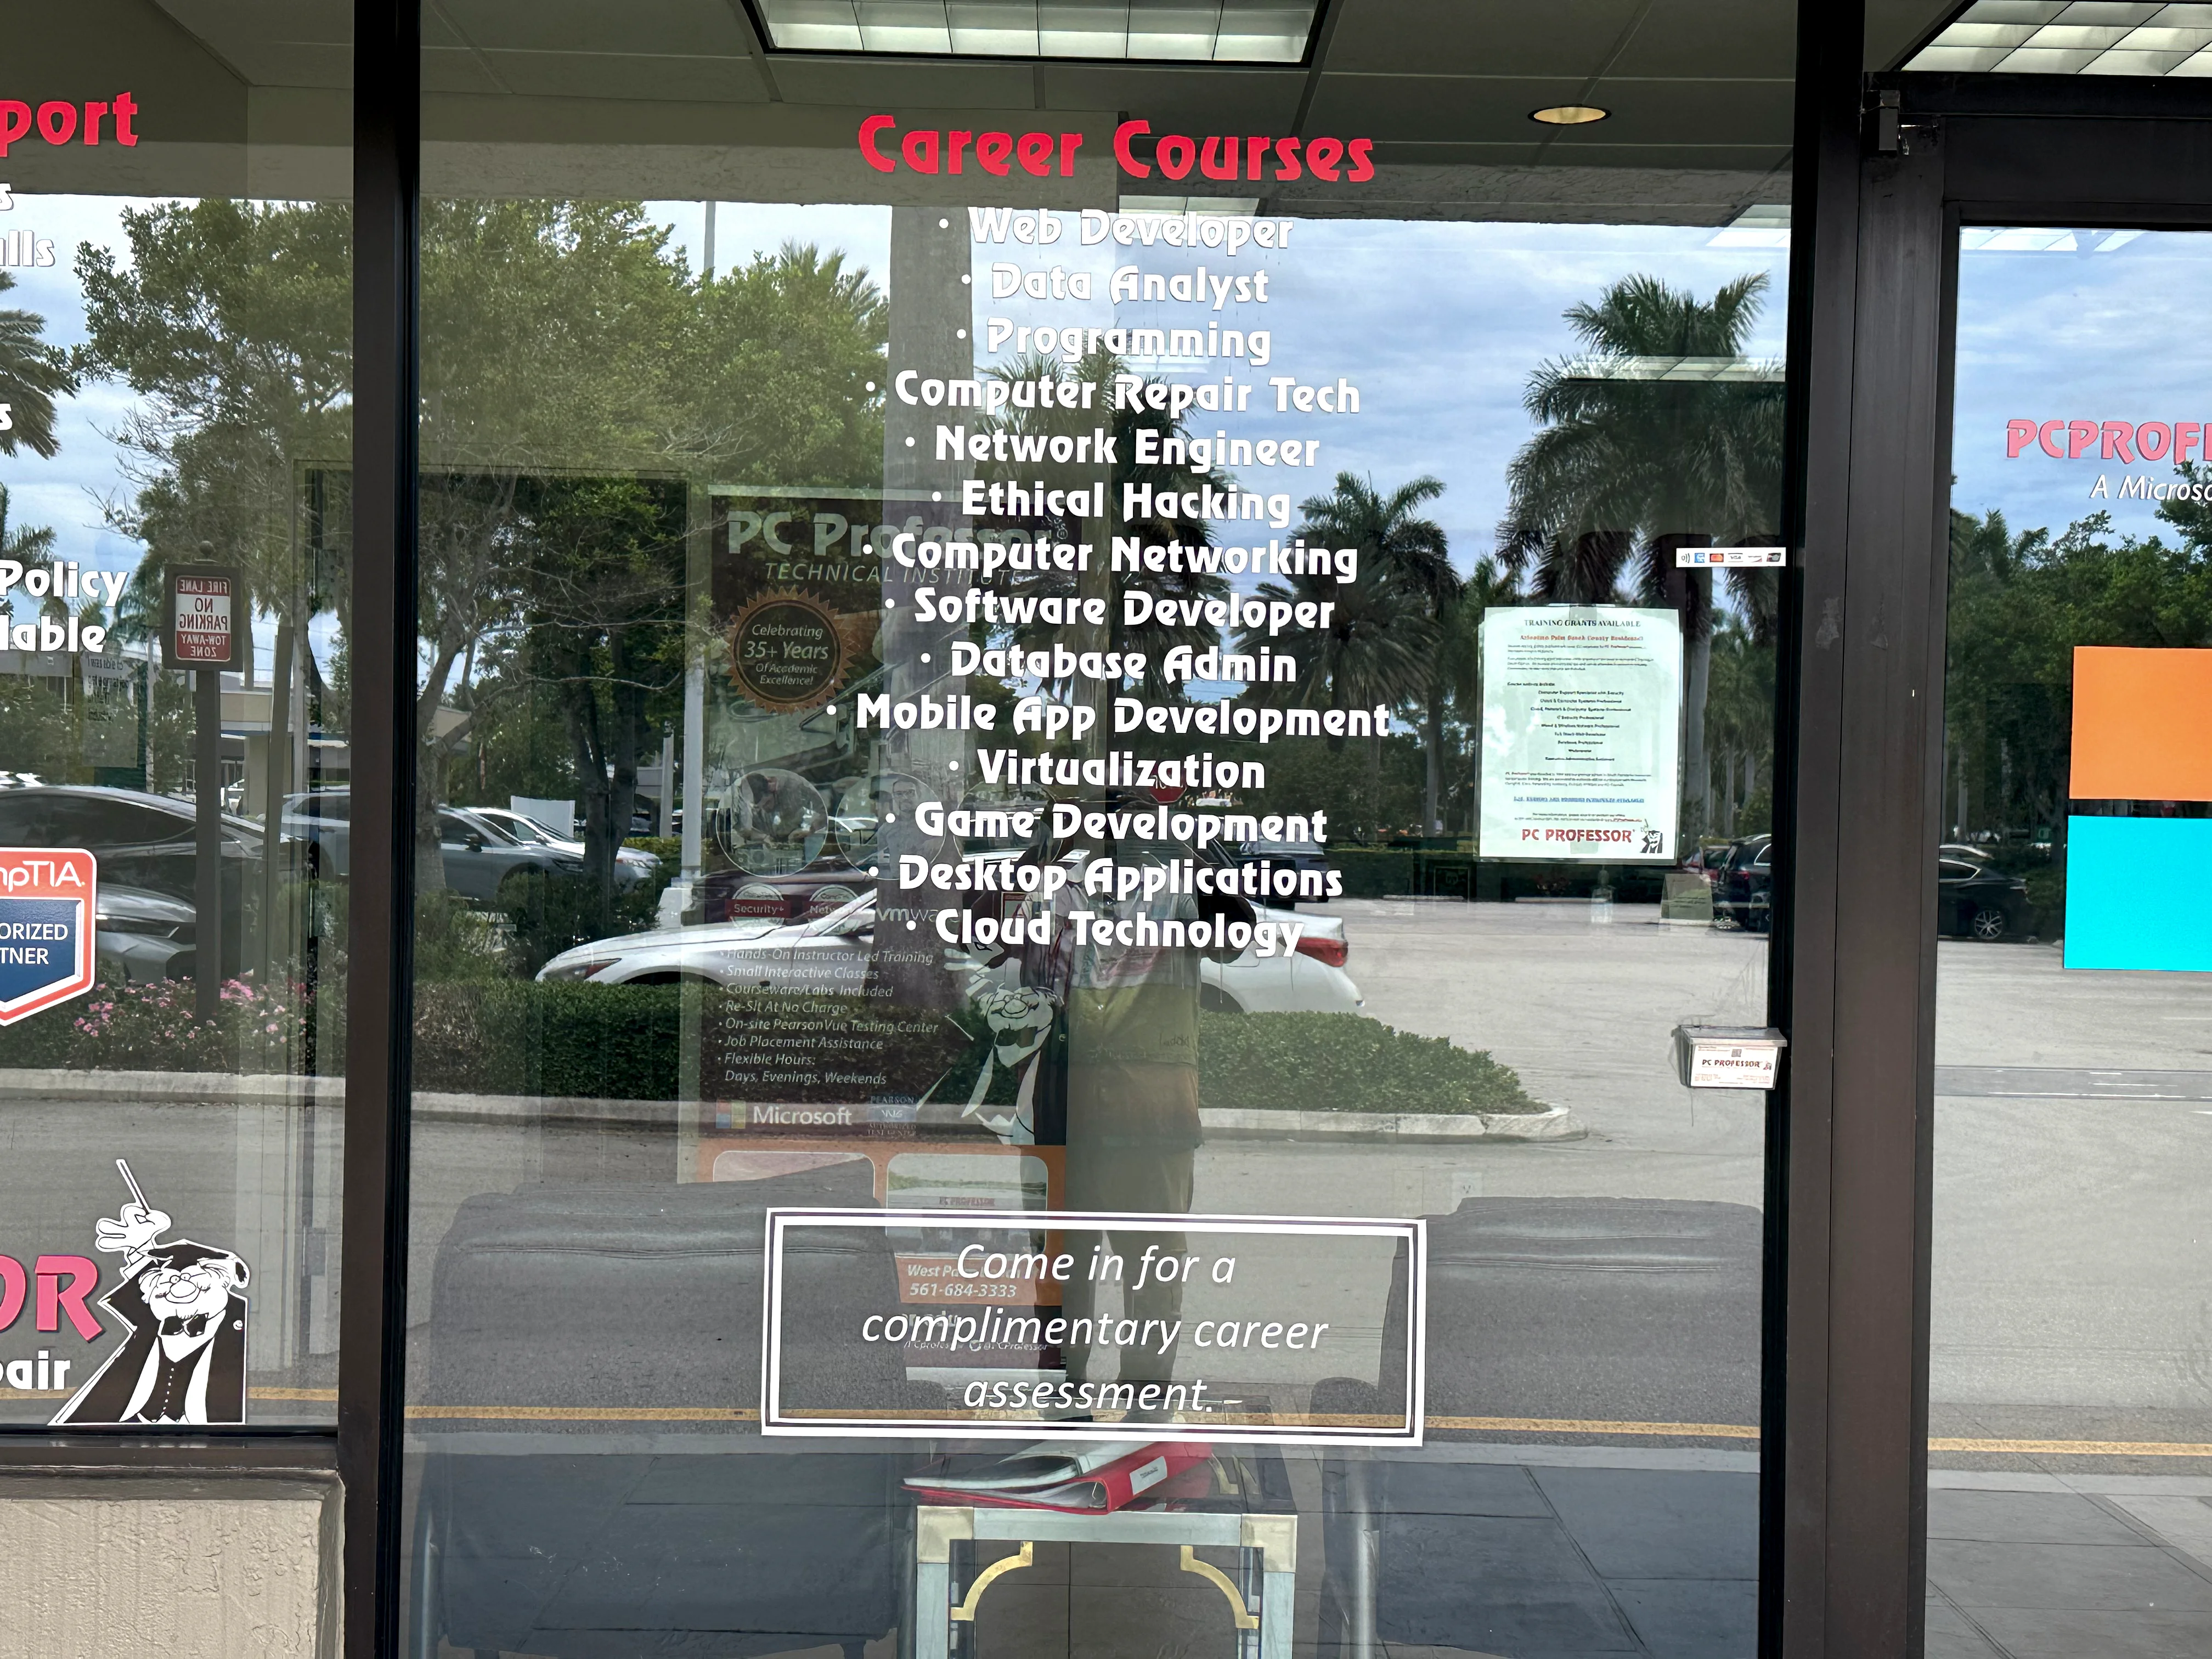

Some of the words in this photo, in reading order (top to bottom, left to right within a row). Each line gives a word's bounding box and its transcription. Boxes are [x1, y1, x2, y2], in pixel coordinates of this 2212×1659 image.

[859, 115, 1082, 176] Career
[1114, 120, 1374, 182] Courses
[0, 230, 55, 267] lls
[968, 207, 1062, 245] Web
[1080, 209, 1294, 256] Developer
[992, 262, 1091, 301] Data
[1109, 266, 1269, 311] Analyst
[987, 317, 1271, 366] Programming
[896, 369, 1096, 415] Computer
[1115, 374, 1251, 418] Repair
[1269, 377, 1360, 413] Tech
[936, 426, 1117, 462] Network
[1136, 429, 1319, 473] Engineer
[2007, 419, 2212, 465] PCPROF
[963, 481, 1103, 516] Ethical
[1124, 483, 1289, 528] Hacking
[2090, 475, 2108, 499] A
[727, 511, 792, 555] PC
[765, 563, 893, 583] TECHNICAL
[893, 533, 1092, 577] Computer
[1111, 537, 1357, 583] Networking
[0, 560, 129, 607] Policy
[752, 623, 823, 640] Celebrating
[915, 588, 1105, 624] Software
[1124, 591, 1334, 636] Developer
[744, 640, 778, 658] 35+
[783, 641, 828, 659] Years
[952, 641, 1146, 679] Database
[1164, 646, 1295, 684] Admin
[857, 694, 996, 730] Mobile
[1013, 697, 1095, 740] App
[1114, 698, 1389, 743] Development
[978, 749, 1264, 788] Virtualization
[915, 803, 1032, 839] Game
[1053, 804, 1327, 849] Development
[1522, 829, 1539, 840] PC
[1545, 829, 1632, 843] PROFESSOR
[900, 855, 1066, 900] Desktop
[1085, 858, 1342, 901] Applications
[734, 904, 785, 915] Security+
[876, 907, 961, 923] vmwa
[936, 909, 1050, 944] Cloud
[1070, 911, 1303, 957] Technology
[726, 965, 762, 977] Small
[765, 966, 832, 978] Interactive
[835, 967, 879, 979] Classes
[793, 950, 854, 962] Instructor
[857, 951, 878, 962] Led
[883, 951, 934, 966] Training
[765, 1002, 778, 1012] At
[782, 1002, 799, 1012] No
[803, 1002, 848, 1016] Charge
[839, 985, 894, 997] Included
[724, 1035, 746, 1047] Job
[749, 1036, 816, 1048] Placement
[818, 1036, 883, 1049] Assistance
[725, 1018, 771, 1030] On-site
[851, 1020, 894, 1034] Testing
[898, 1022, 940, 1033] Center
[724, 1053, 771, 1065] Flexible
[775, 1054, 816, 1065] Hours:
[725, 1070, 758, 1083] Days,
[762, 1071, 820, 1085] Evenings,
[825, 1072, 887, 1085] Weekends
[753, 1105, 852, 1126] Microsoft
[908, 1265, 941, 1277] West
[958, 1245, 1074, 1279] Come
[1089, 1246, 1123, 1280] in
[1133, 1245, 1199, 1289] for
[1212, 1258, 1235, 1283] a
[910, 1283, 1017, 1297] 561-684-3333
[863, 1307, 1181, 1354] complimentary
[1195, 1322, 1328, 1348] career
[0, 1350, 70, 1390] air
[964, 1380, 1211, 1412] assessment.
